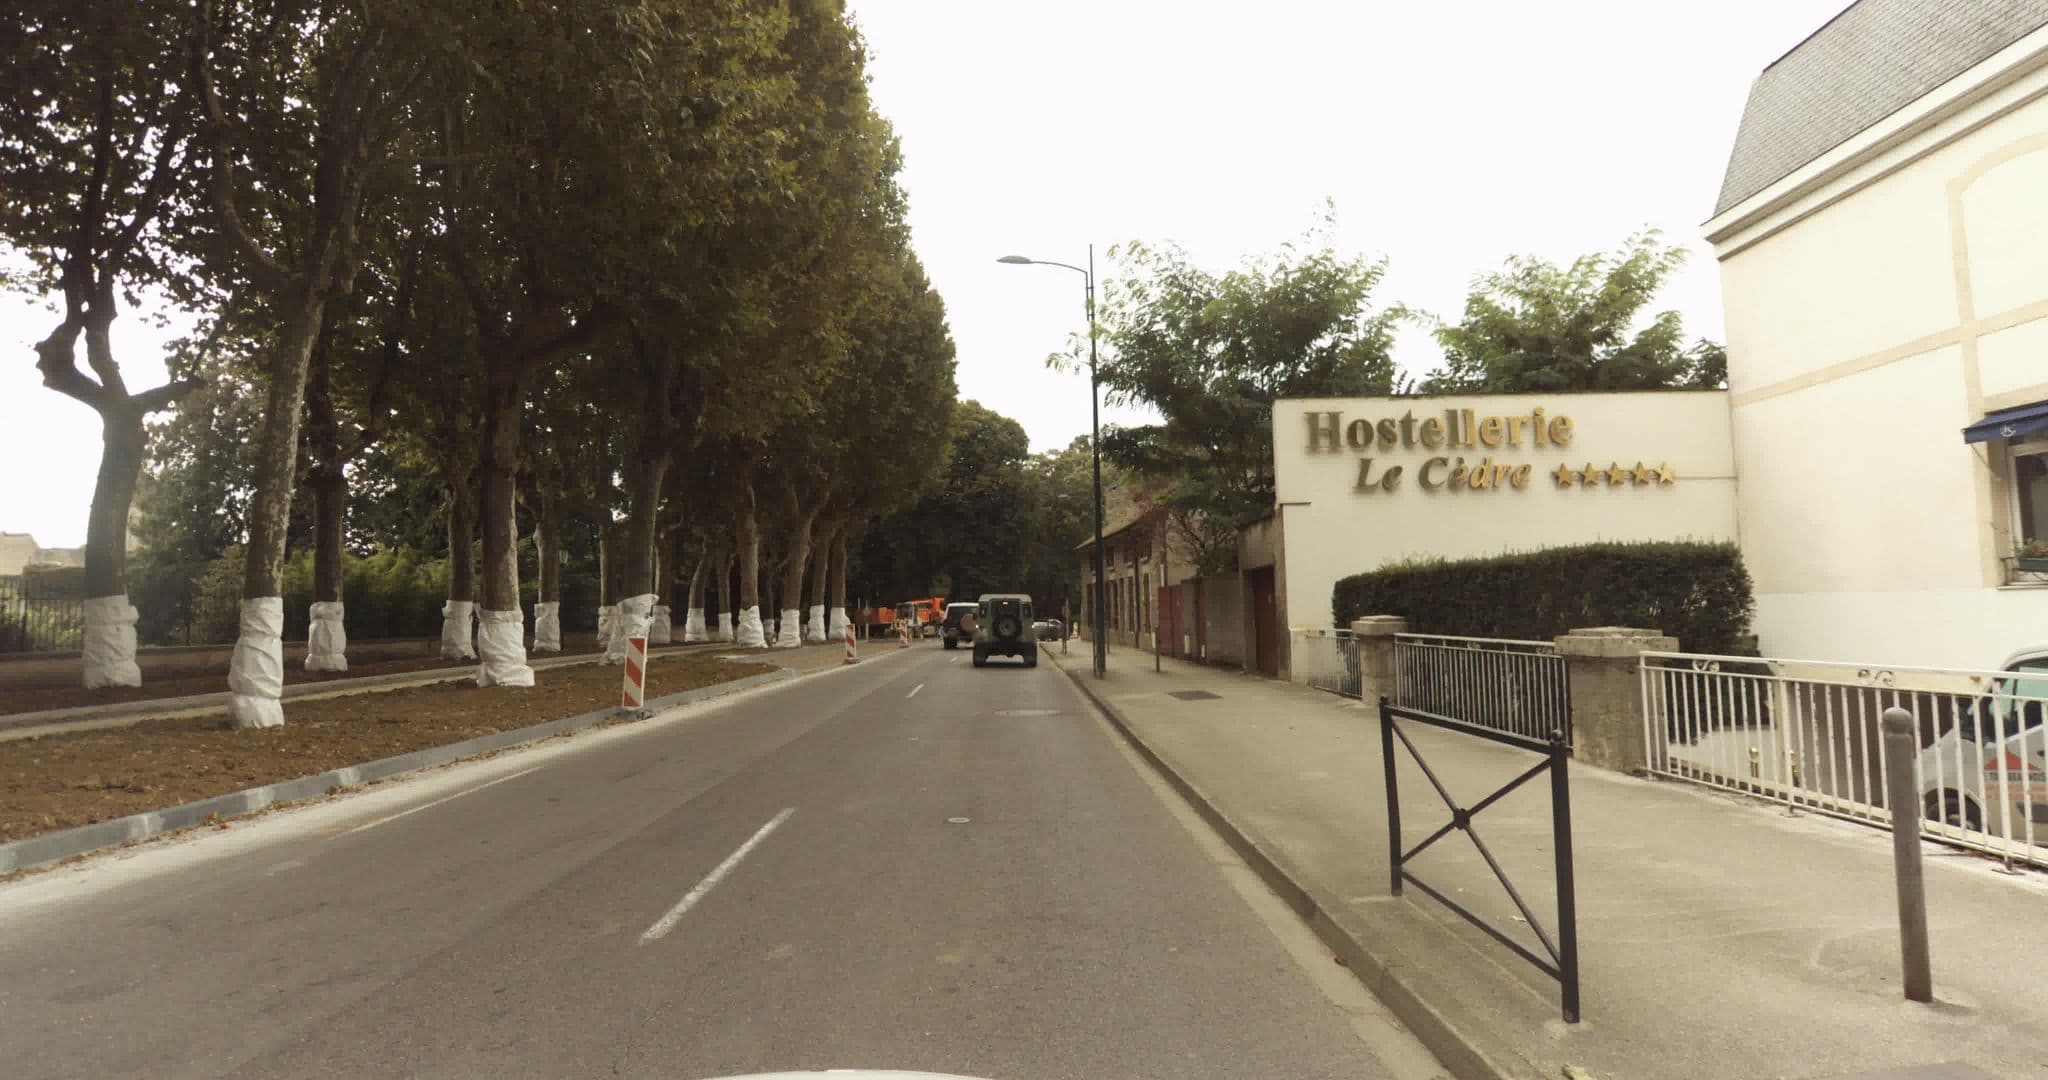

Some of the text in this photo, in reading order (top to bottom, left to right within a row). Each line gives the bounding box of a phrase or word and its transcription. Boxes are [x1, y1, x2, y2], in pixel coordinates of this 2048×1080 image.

[1305, 406, 1575, 450] Hostellerie
[1354, 456, 1532, 493] Le Cèdre
